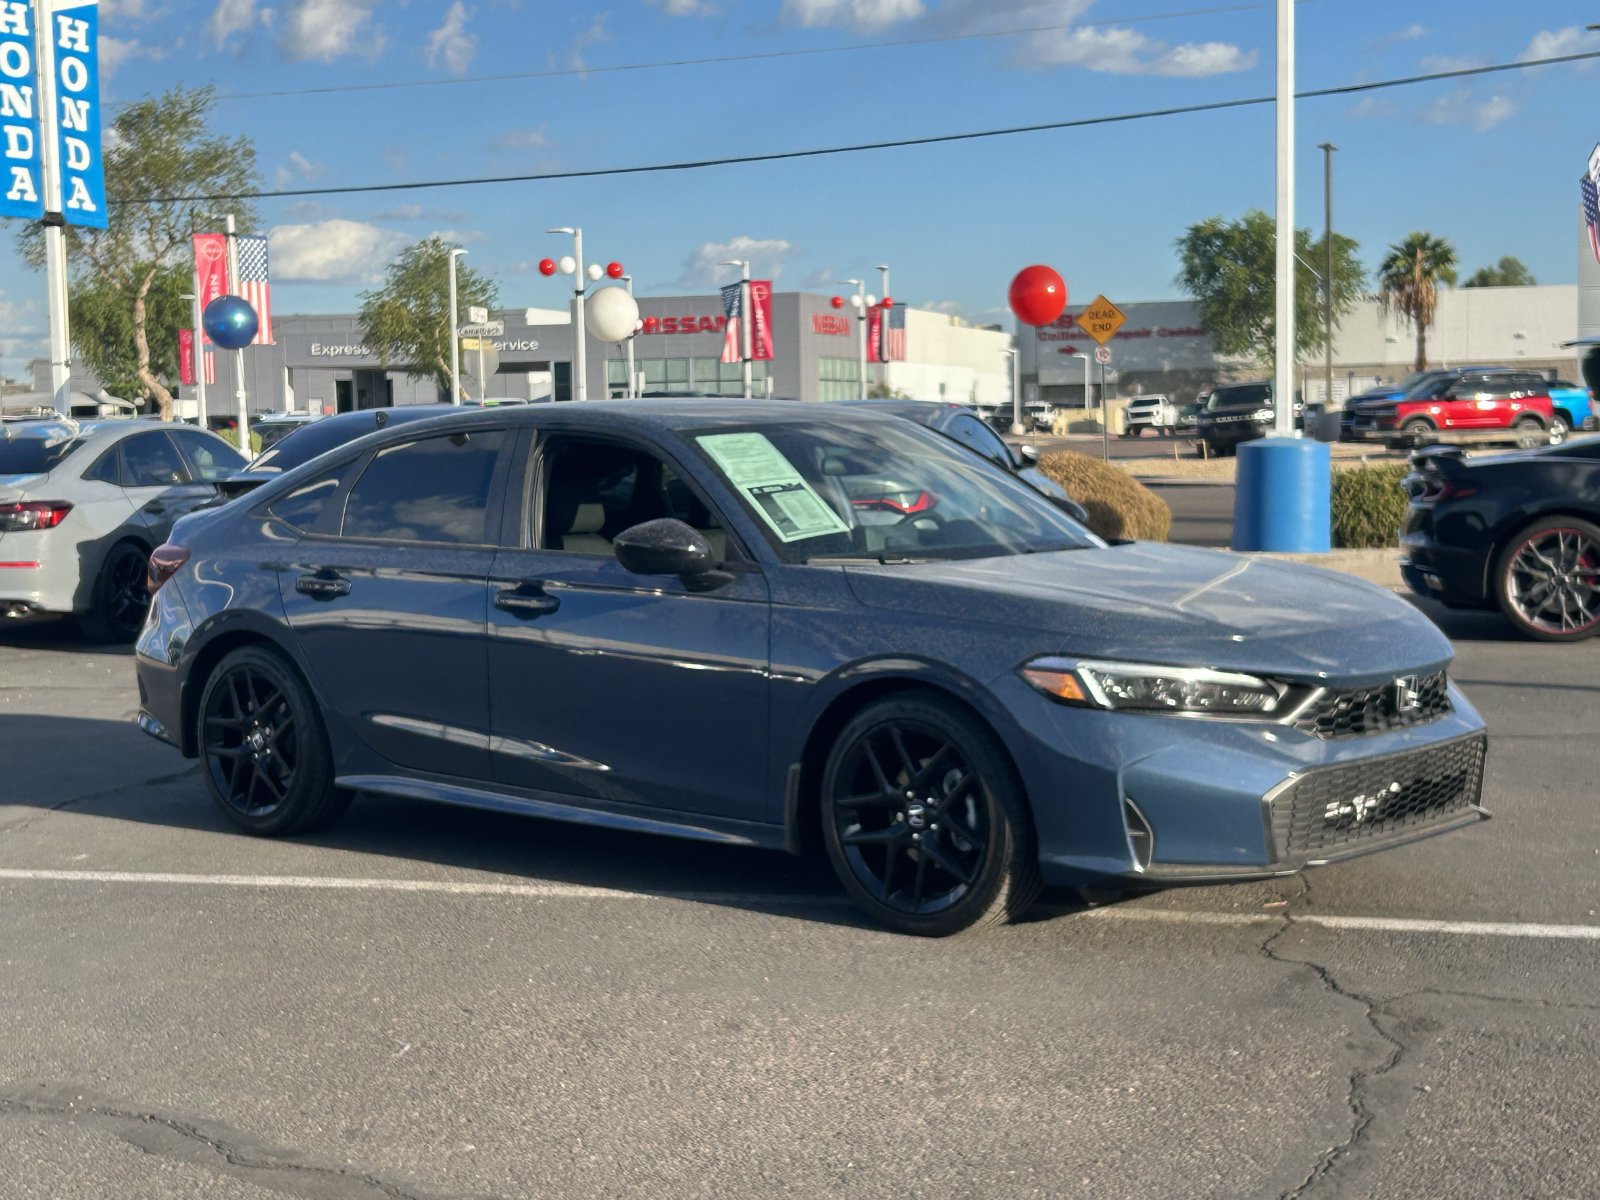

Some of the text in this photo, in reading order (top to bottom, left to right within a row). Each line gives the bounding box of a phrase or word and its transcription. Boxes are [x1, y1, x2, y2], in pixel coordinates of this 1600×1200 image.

[0, 1, 38, 203] HONDA
[57, 14, 97, 212] HONDA
[1088, 309, 1115, 320] DEAD
[1092, 322, 1112, 332] END
[493, 338, 540, 351] ervice
